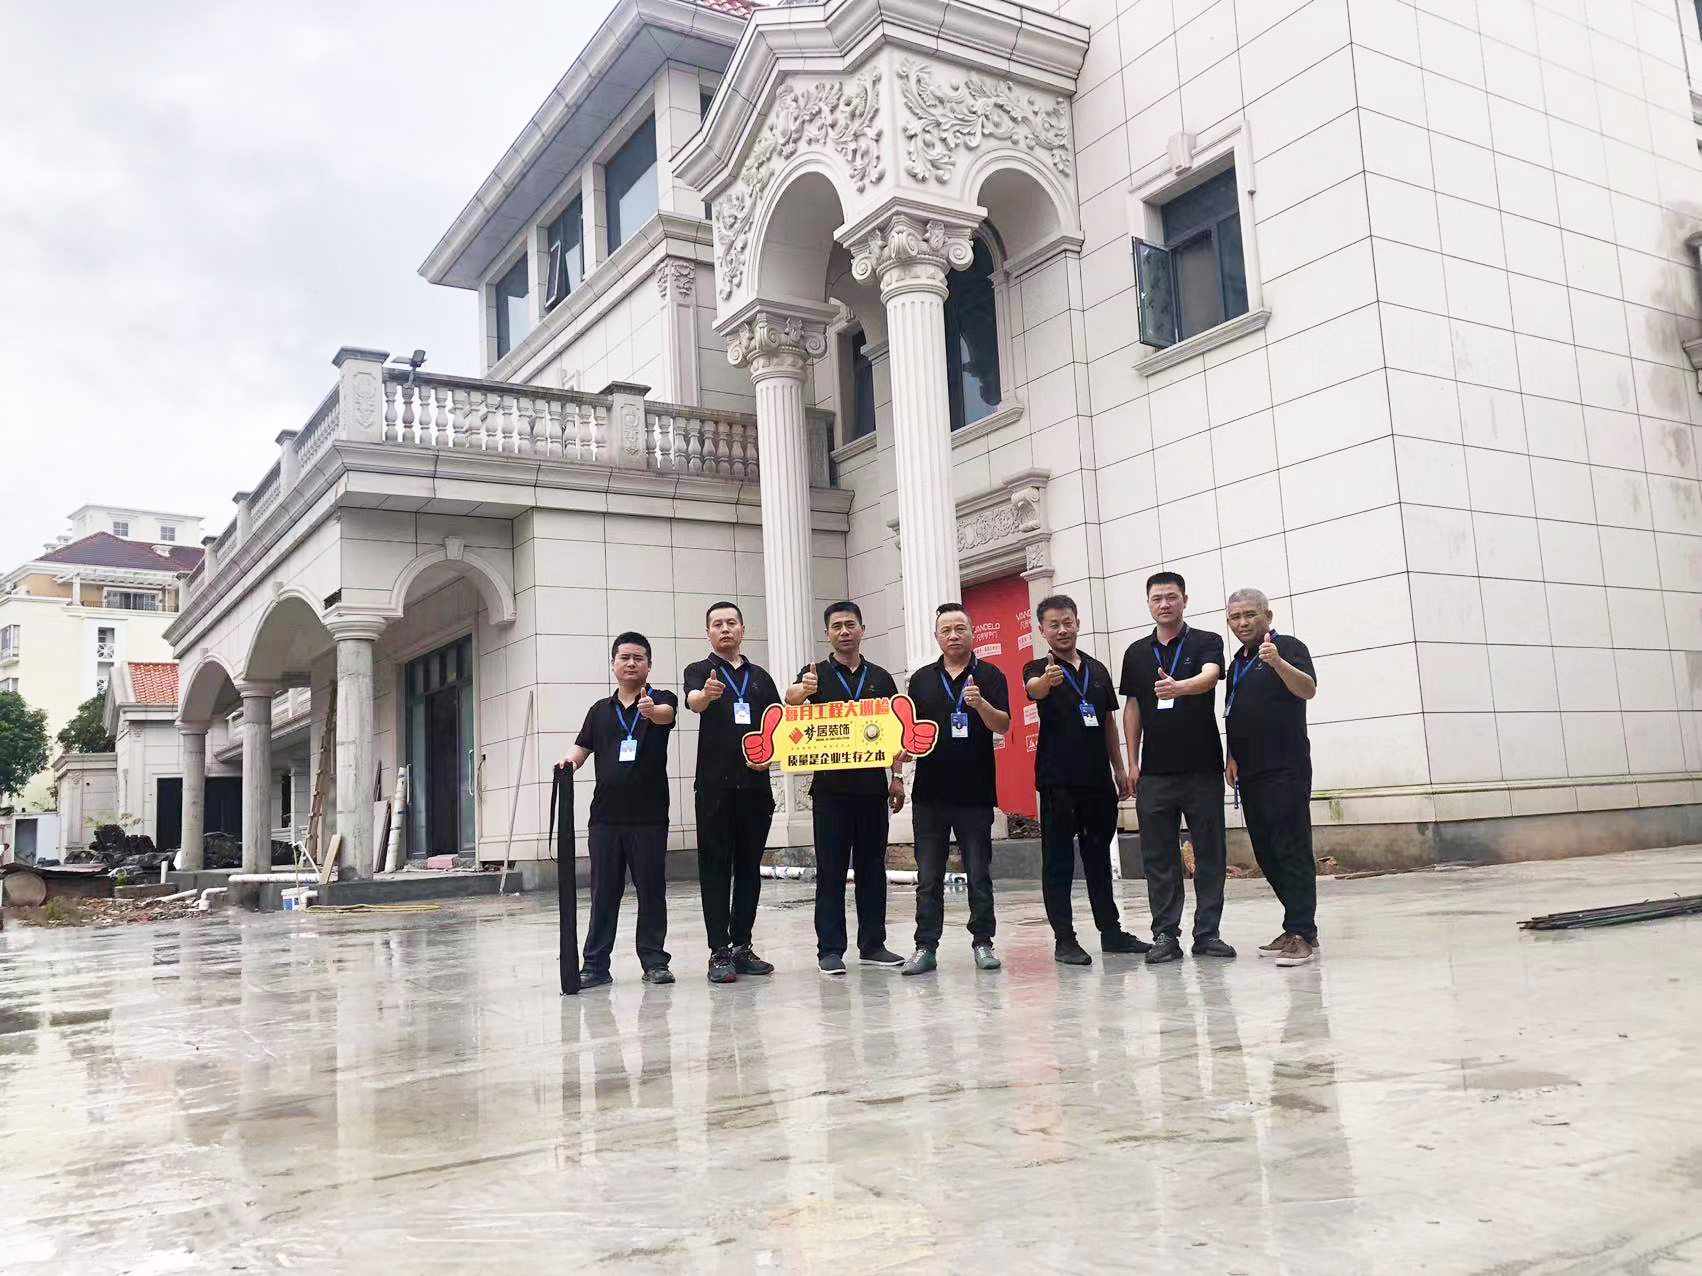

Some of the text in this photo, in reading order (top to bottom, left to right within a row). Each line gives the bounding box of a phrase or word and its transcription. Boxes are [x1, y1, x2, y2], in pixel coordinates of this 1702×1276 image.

[784, 698, 890, 722] 每月工程大巡检
[804, 723, 850, 744] 梦居装饰
[787, 750, 886, 767] 质量是企业生存之本
